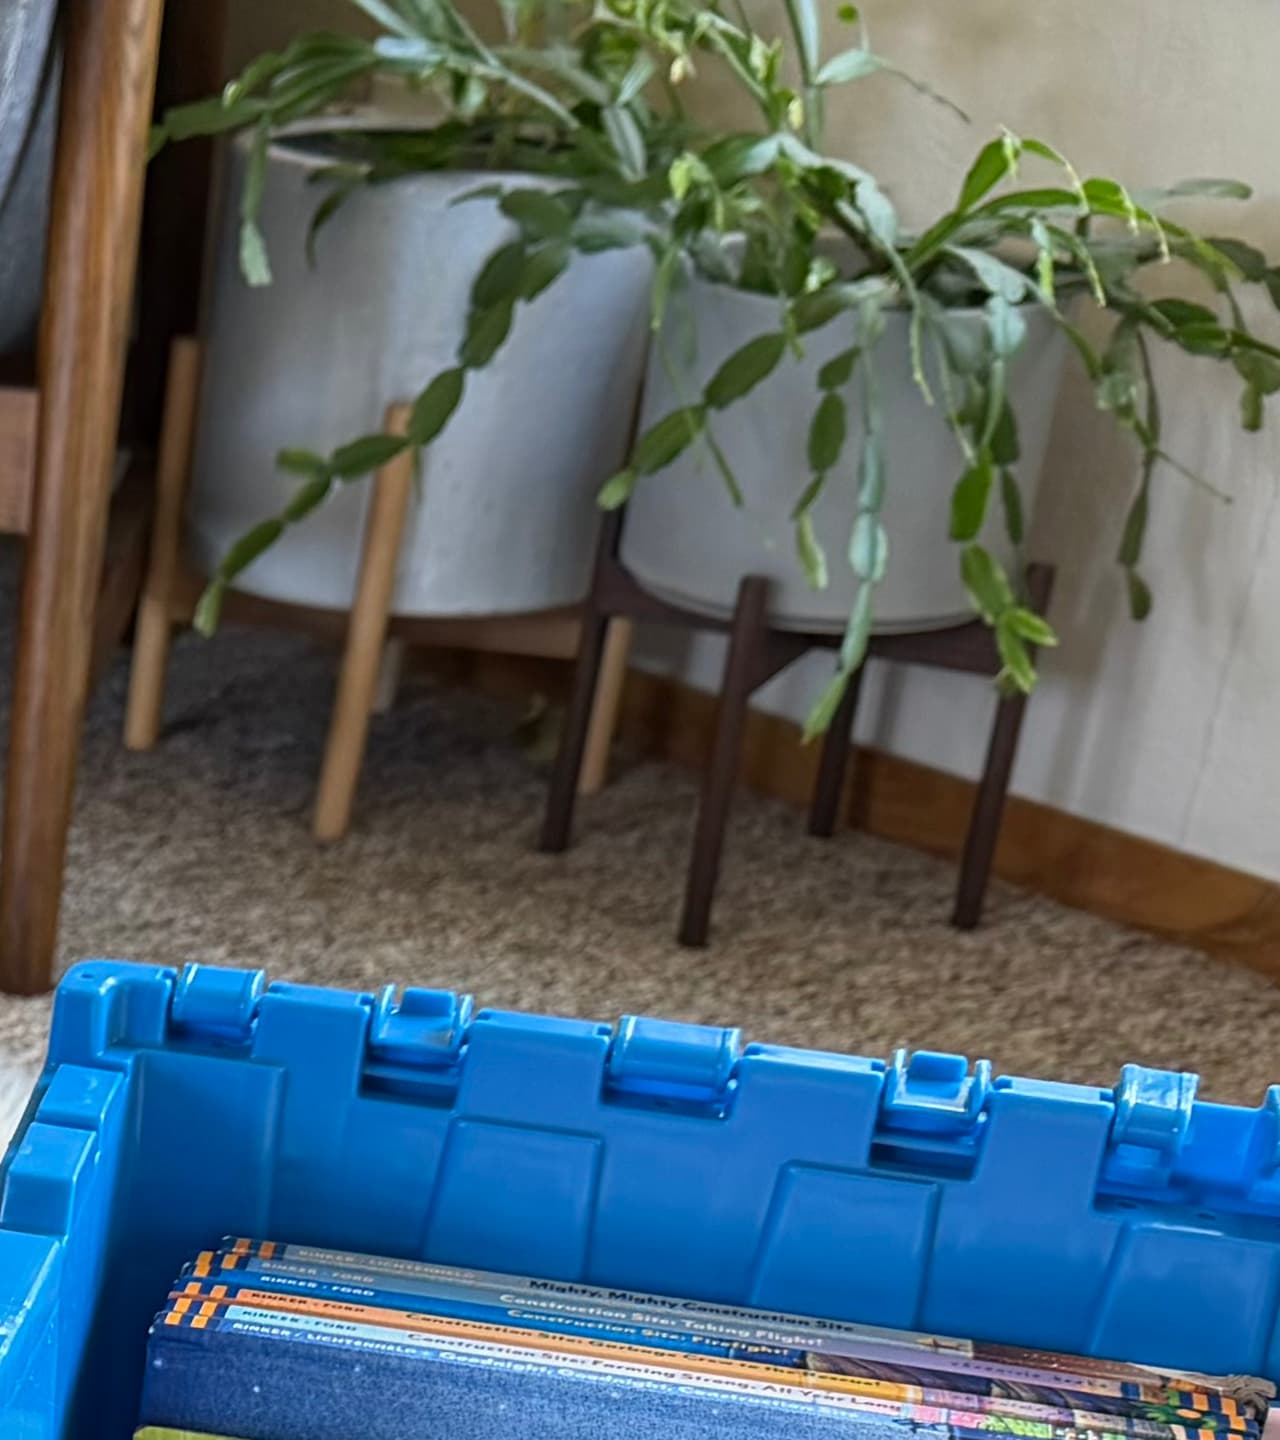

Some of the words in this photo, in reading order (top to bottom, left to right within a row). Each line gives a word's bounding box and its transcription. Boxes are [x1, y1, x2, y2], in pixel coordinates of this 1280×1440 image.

[232, 1321, 291, 1338] RINKER
[499, 1293, 627, 1319] Construction
[631, 1311, 676, 1326] Site:
[680, 1318, 752, 1339] Taking
[755, 1329, 824, 1347] Flight!
[507, 1308, 637, 1335] Construction
[641, 1328, 686, 1341] Site:
[608, 1291, 678, 1309] Mighty
[681, 1301, 810, 1327] Construction
[814, 1319, 855, 1332] Site
[405, 1312, 533, 1338] Construction
[588, 1339, 678, 1359] Garbage
[408, 1333, 536, 1358] Construction
[592, 1359, 676, 1379] Farming
[800, 1388, 848, 1404] Year
[850, 1397, 901, 1413] Long
